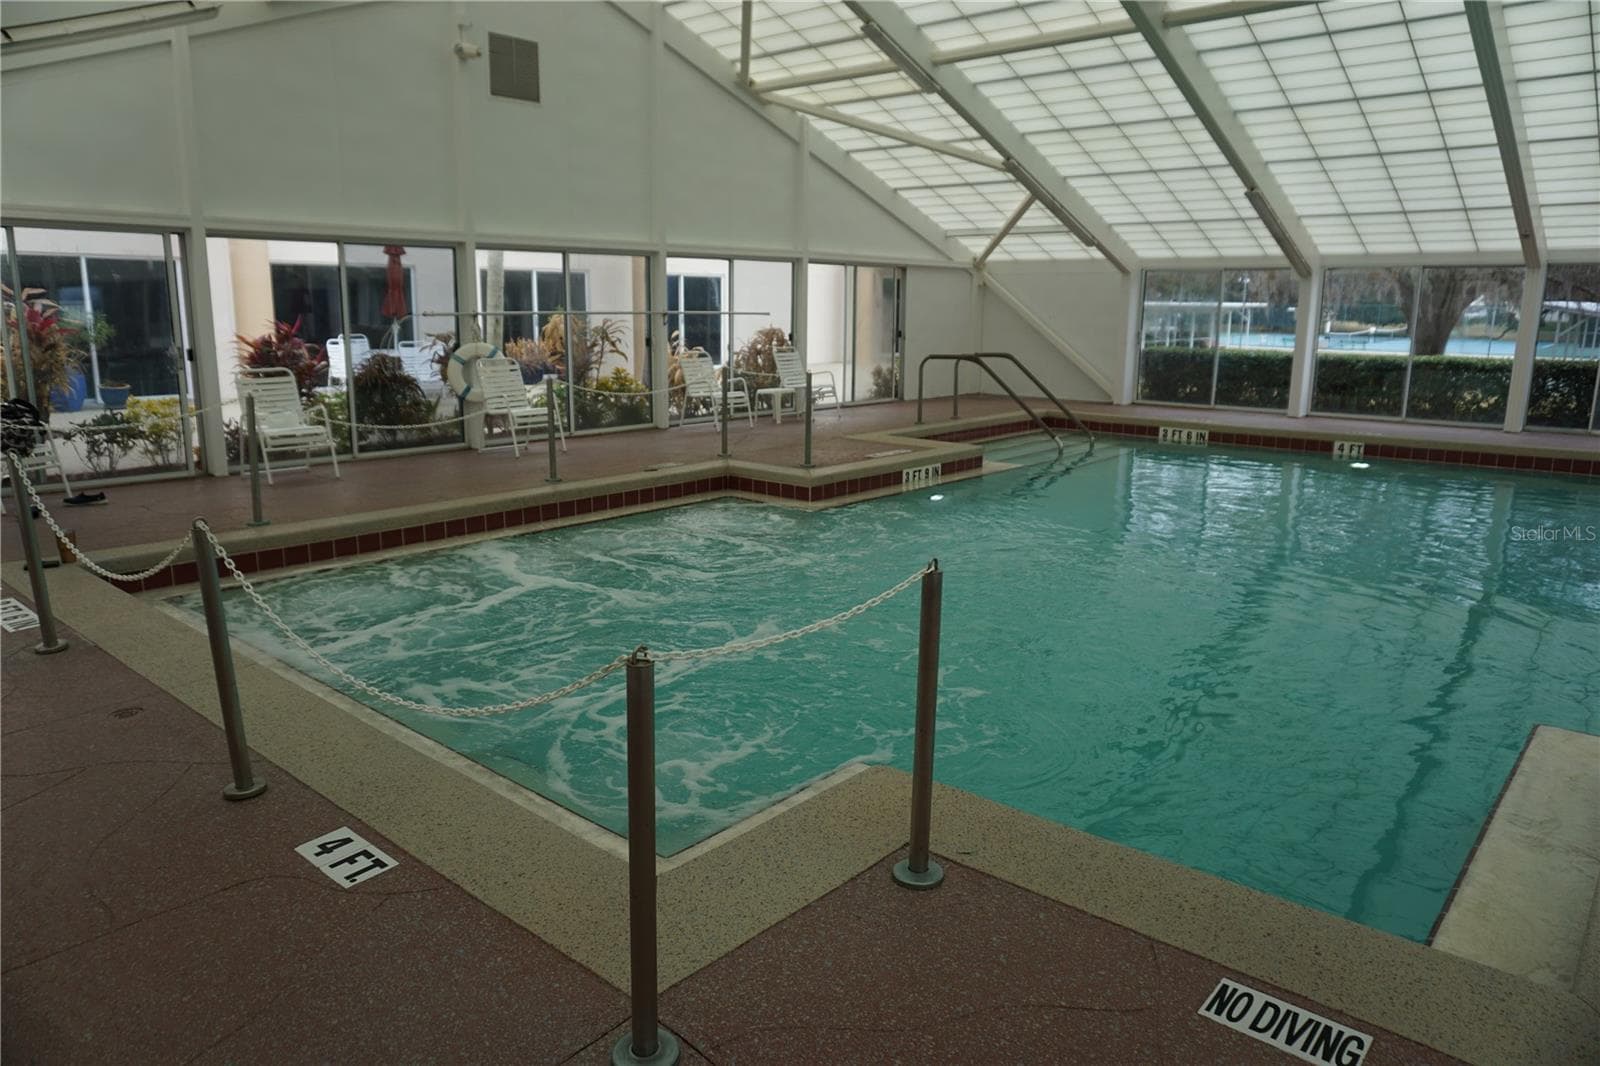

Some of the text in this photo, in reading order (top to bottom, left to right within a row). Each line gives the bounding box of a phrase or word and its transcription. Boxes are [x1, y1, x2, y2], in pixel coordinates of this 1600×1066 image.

[1172, 429, 1183, 439] FT
[1196, 431, 1207, 441] IN
[1337, 443, 1362, 454] 4 FT
[905, 465, 940, 481] 3 FT 9 IN
[313, 837, 354, 857] 4
[1205, 983, 1365, 1066] NO DIVING
